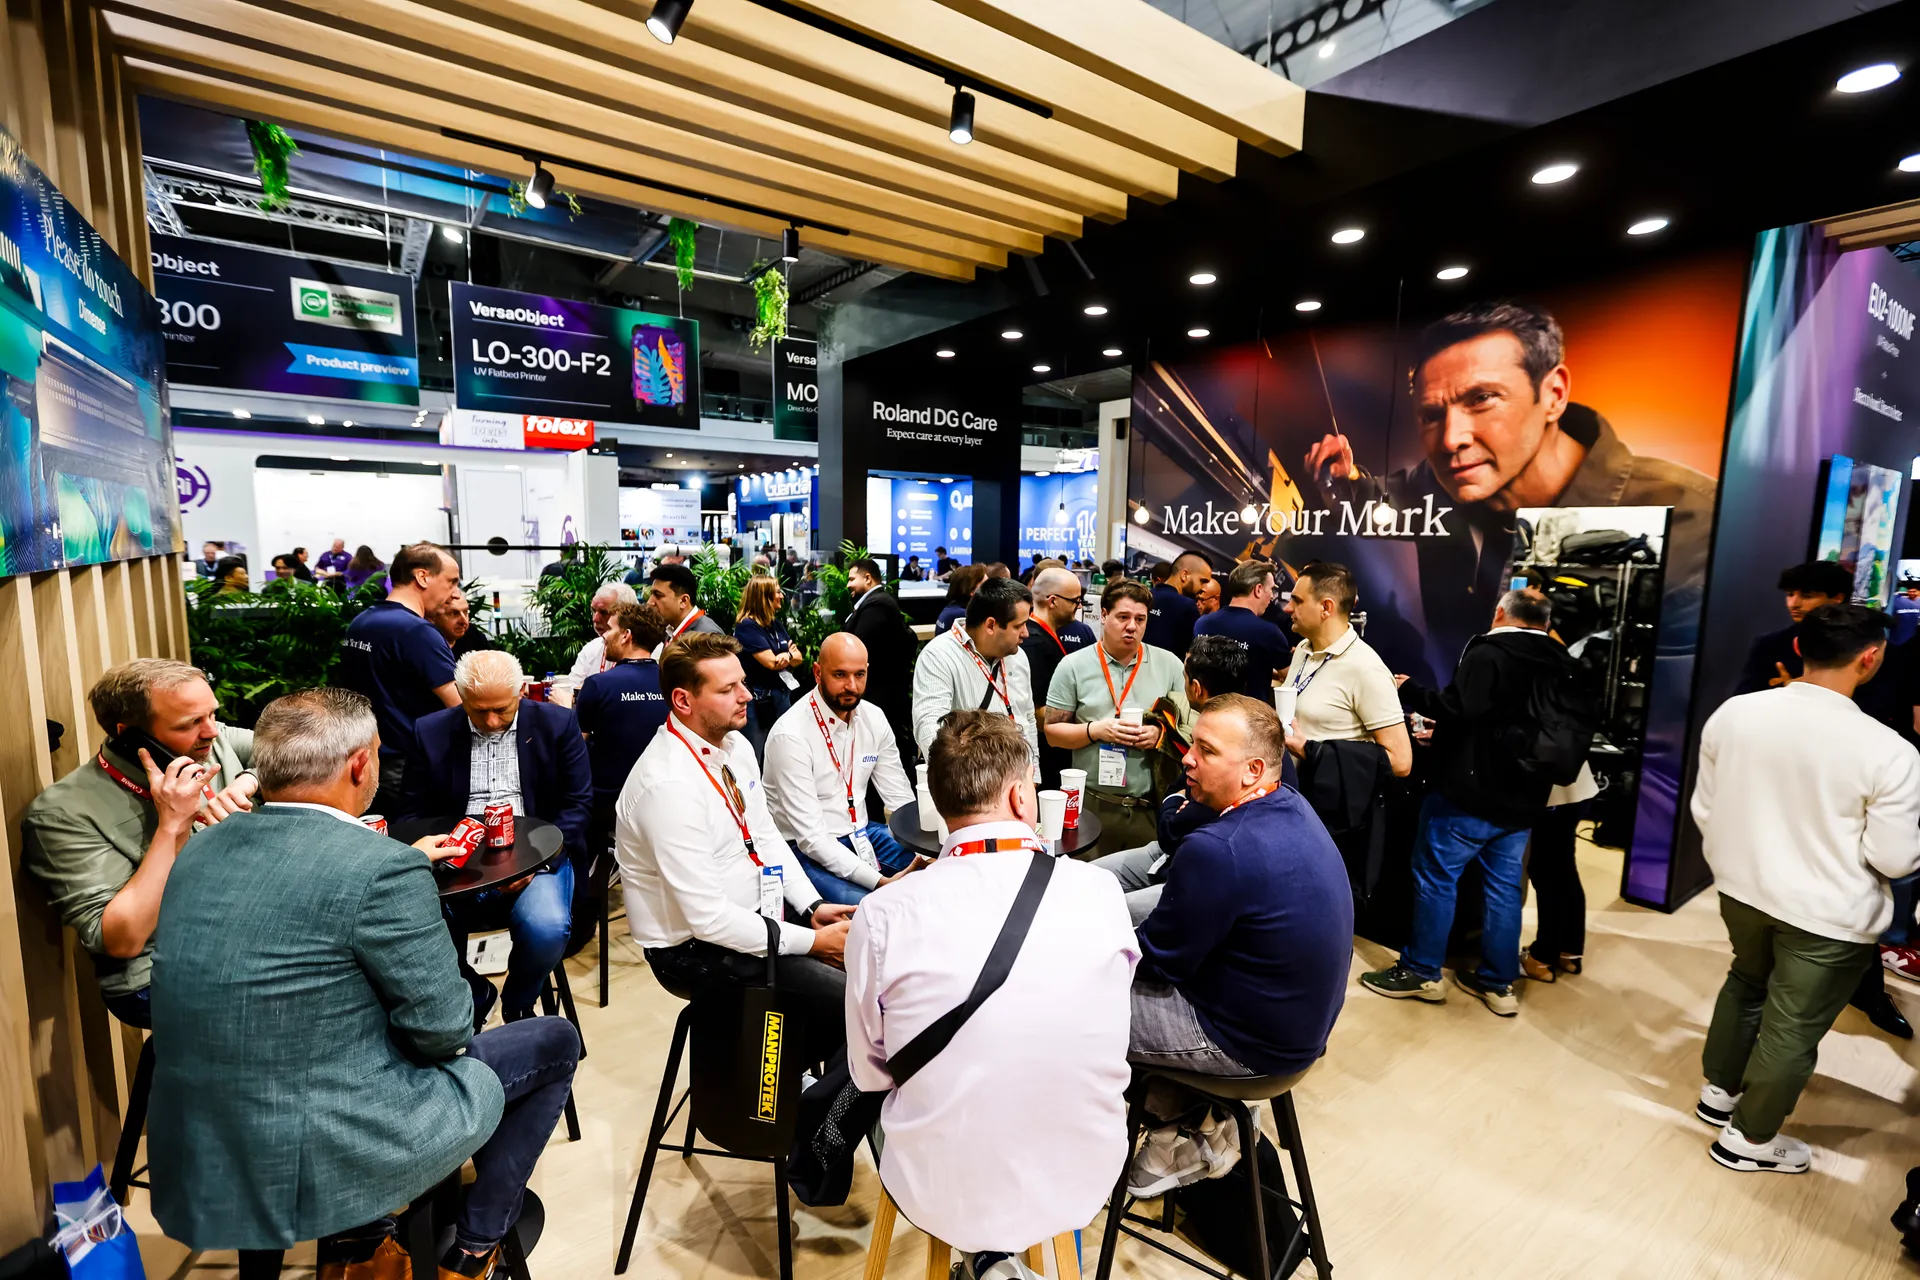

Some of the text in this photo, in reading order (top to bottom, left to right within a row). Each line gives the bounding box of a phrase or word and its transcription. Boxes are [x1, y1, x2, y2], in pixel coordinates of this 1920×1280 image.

[42, 212, 124, 318] Please do touch
[78, 298, 107, 336] Dimense
[469, 301, 565, 327] VersaObject
[306, 354, 410, 377] Product preview
[472, 338, 612, 376] LO-300-F2
[786, 352, 817, 365] Versa
[474, 366, 547, 382] UV Flatbed Printer
[787, 382, 819, 402] MO
[873, 401, 998, 432] Roland DG Care
[886, 428, 983, 447] Expect care at every layer
[1162, 494, 1453, 537] Make Your Mark
[1026, 527, 1076, 542] PERFECT
[1064, 634, 1081, 643] Mark
[621, 692, 665, 701] Make You
[761, 1014, 781, 1115] MANPROTEK
